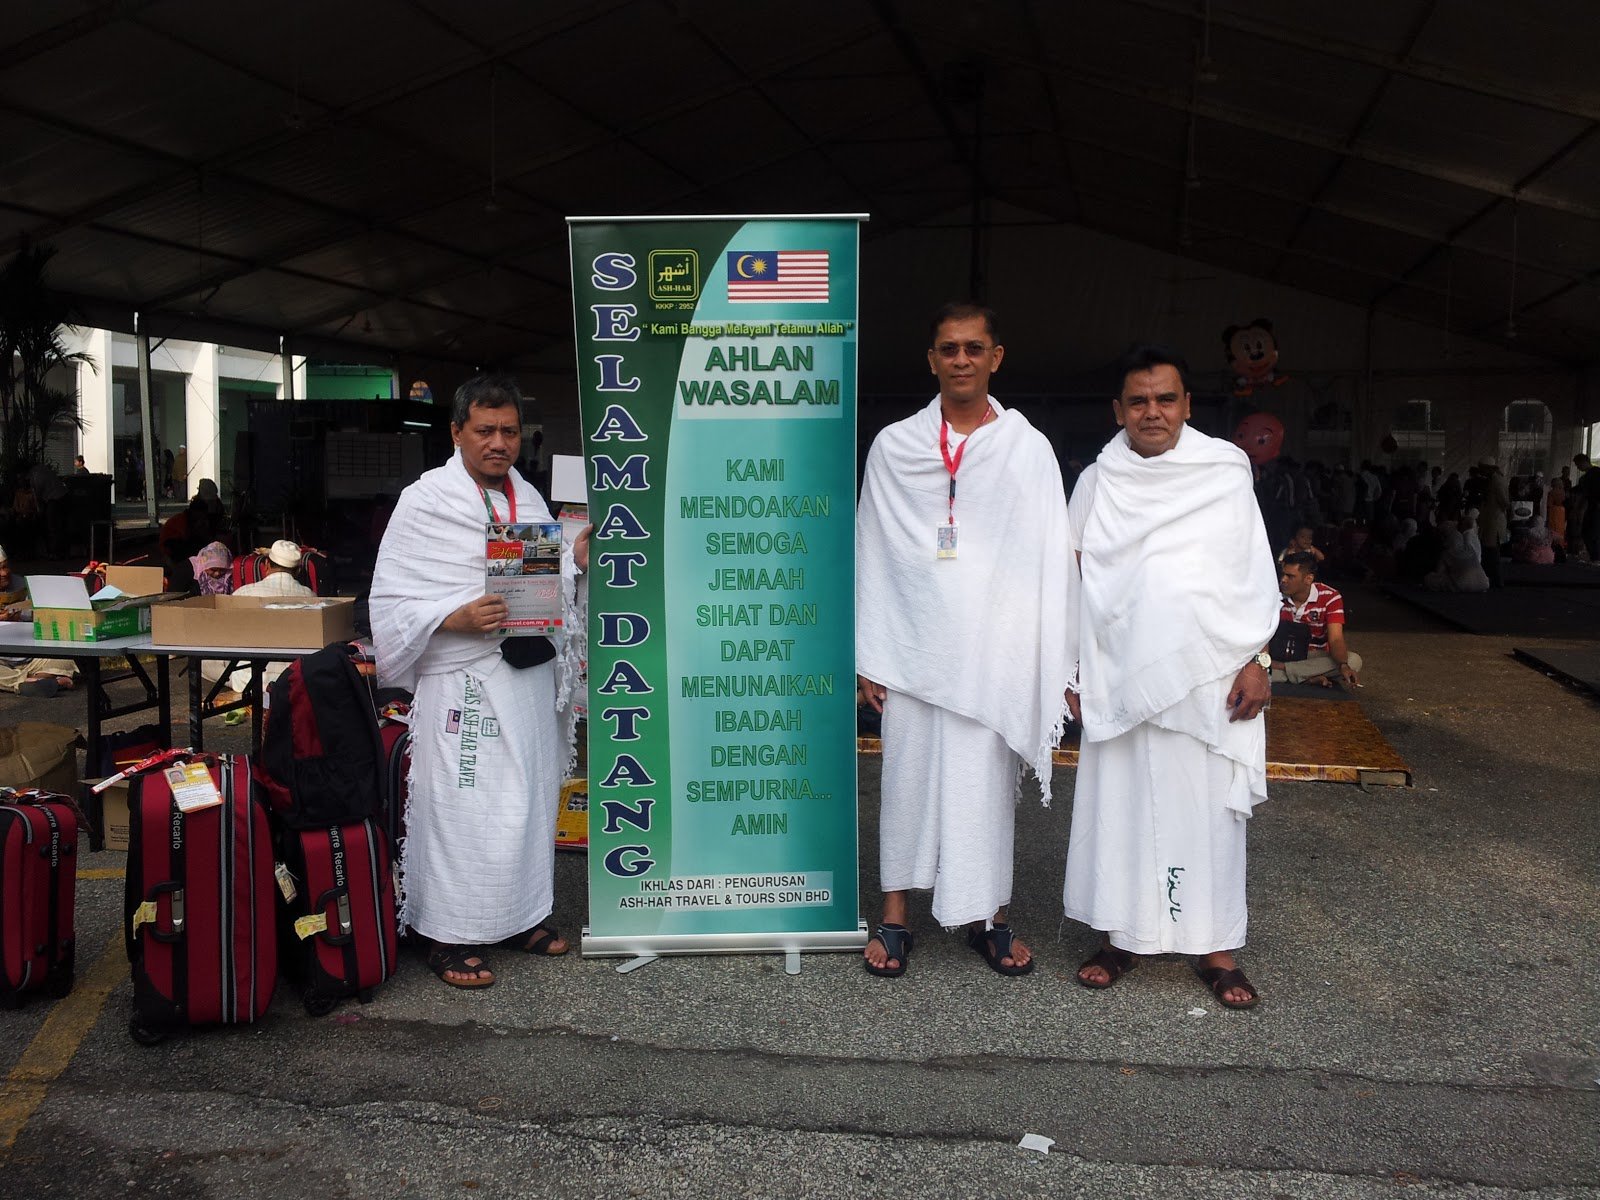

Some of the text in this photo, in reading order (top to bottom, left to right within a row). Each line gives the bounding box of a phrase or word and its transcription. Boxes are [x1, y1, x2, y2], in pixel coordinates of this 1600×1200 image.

[657, 284, 692, 292] ASH-HAR
[651, 323, 678, 335] Kami
[681, 323, 722, 338] Bangga
[725, 323, 772, 338] Melayani
[775, 323, 814, 335] Tetamu
[816, 323, 844, 335] Allah
[704, 345, 814, 372] AHLAN
[679, 379, 840, 406] WASALAM
[726, 458, 785, 482] KAMI
[680, 495, 830, 519] MENDOAKAN
[706, 531, 808, 555] SEMOGA
[591, 252, 656, 877] SELAMAT DATANG
[708, 568, 804, 591] JEMAAH
[696, 603, 817, 627] SIHAT DAN
[721, 639, 795, 662] DAPAT
[681, 674, 833, 698] MENUNAIKAN
[461, 707, 480, 751] ASH-HAR
[715, 709, 802, 732] IBADAH
[711, 744, 807, 767] DENGAN
[459, 754, 476, 788] TRAVEL
[686, 778, 832, 803] SEMPURNA...
[173, 812, 183, 850] Recarlo
[730, 813, 788, 836] AMIN
[52, 831, 60, 868] Recarlo
[334, 852, 345, 887] Recarlo
[641, 879, 683, 892] IKHLAS
[687, 878, 715, 890] DARI
[725, 875, 805, 889] PENGURUSAN
[619, 890, 830, 909] ASH-HAR TRAVEL & TOURS SDN BHD
